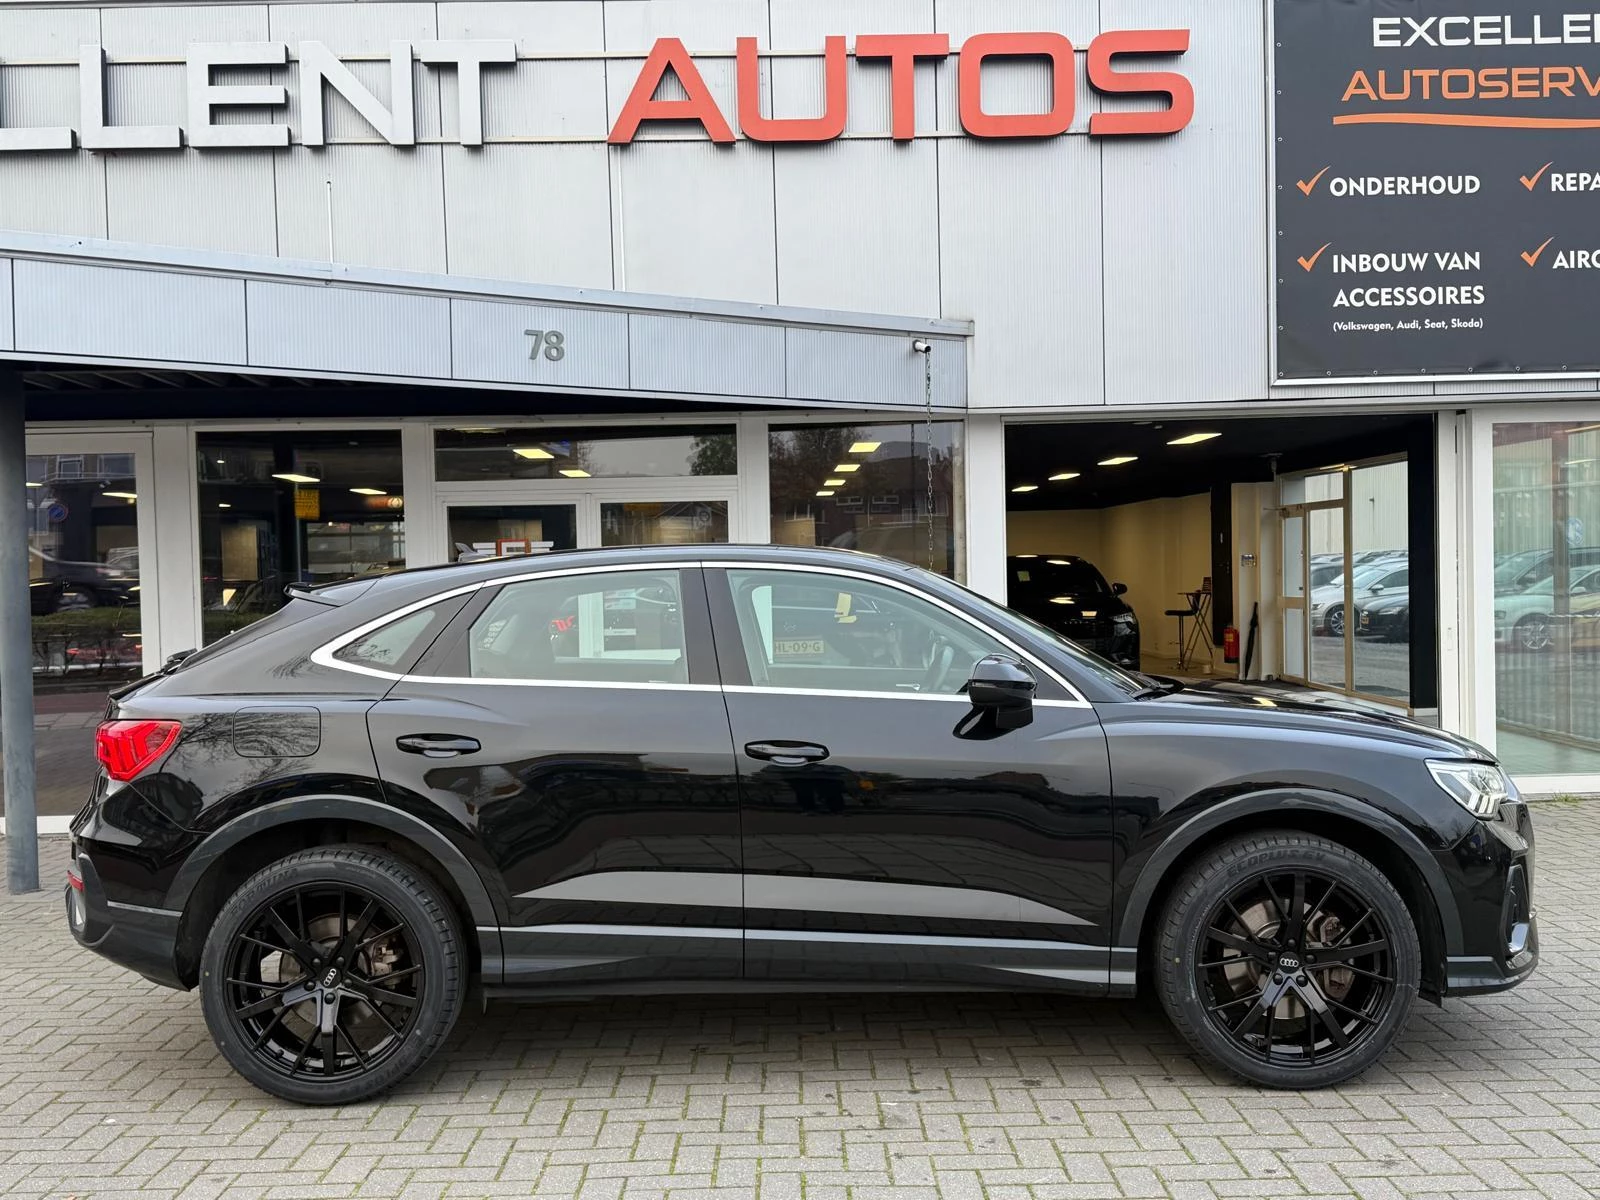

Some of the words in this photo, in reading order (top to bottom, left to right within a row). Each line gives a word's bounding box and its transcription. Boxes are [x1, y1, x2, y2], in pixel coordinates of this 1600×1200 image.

[1373, 14, 1600, 47] EXCELLE
[607, 29, 1194, 145] AUTOS
[1330, 175, 1481, 197] ONDERHOUD
[1332, 252, 1429, 273] INBOUW
[1433, 251, 1481, 271] VAN
[1333, 285, 1486, 308] ACCESSOIRES
[1333, 321, 1395, 333] (Volkswagen,
[1397, 319, 1422, 331] Audi,
[1424, 319, 1449, 330] Seat,
[1451, 318, 1484, 330] Skoda)
[524, 329, 566, 362] 78
